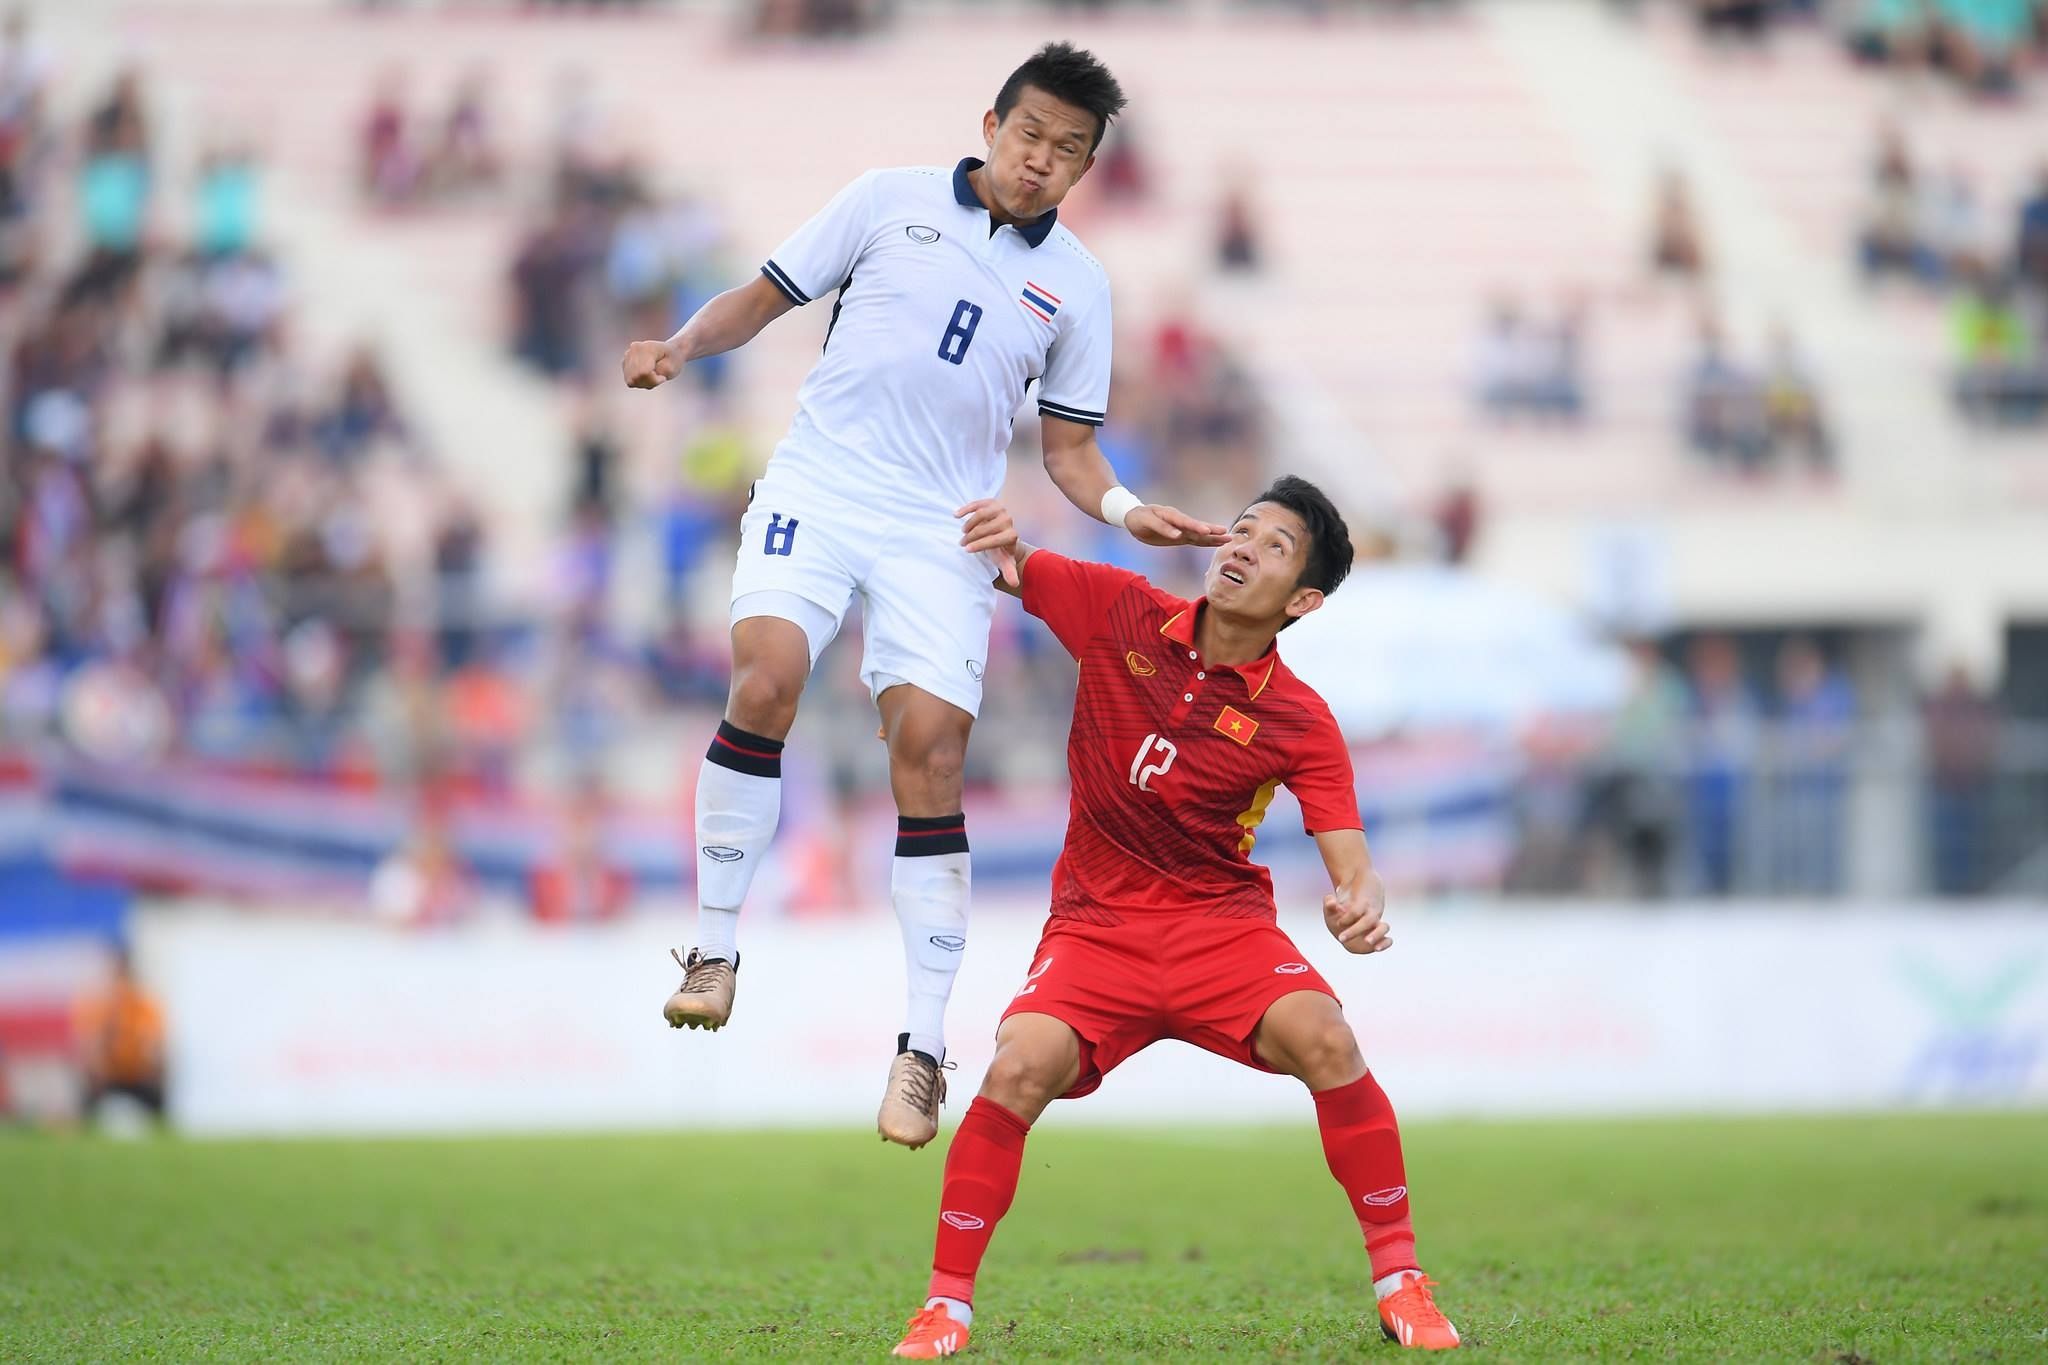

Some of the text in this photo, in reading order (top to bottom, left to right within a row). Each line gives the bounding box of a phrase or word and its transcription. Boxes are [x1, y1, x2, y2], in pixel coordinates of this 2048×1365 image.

[937, 299, 984, 366] 8
[763, 512, 800, 557] 8
[1129, 733, 1178, 794] 12
